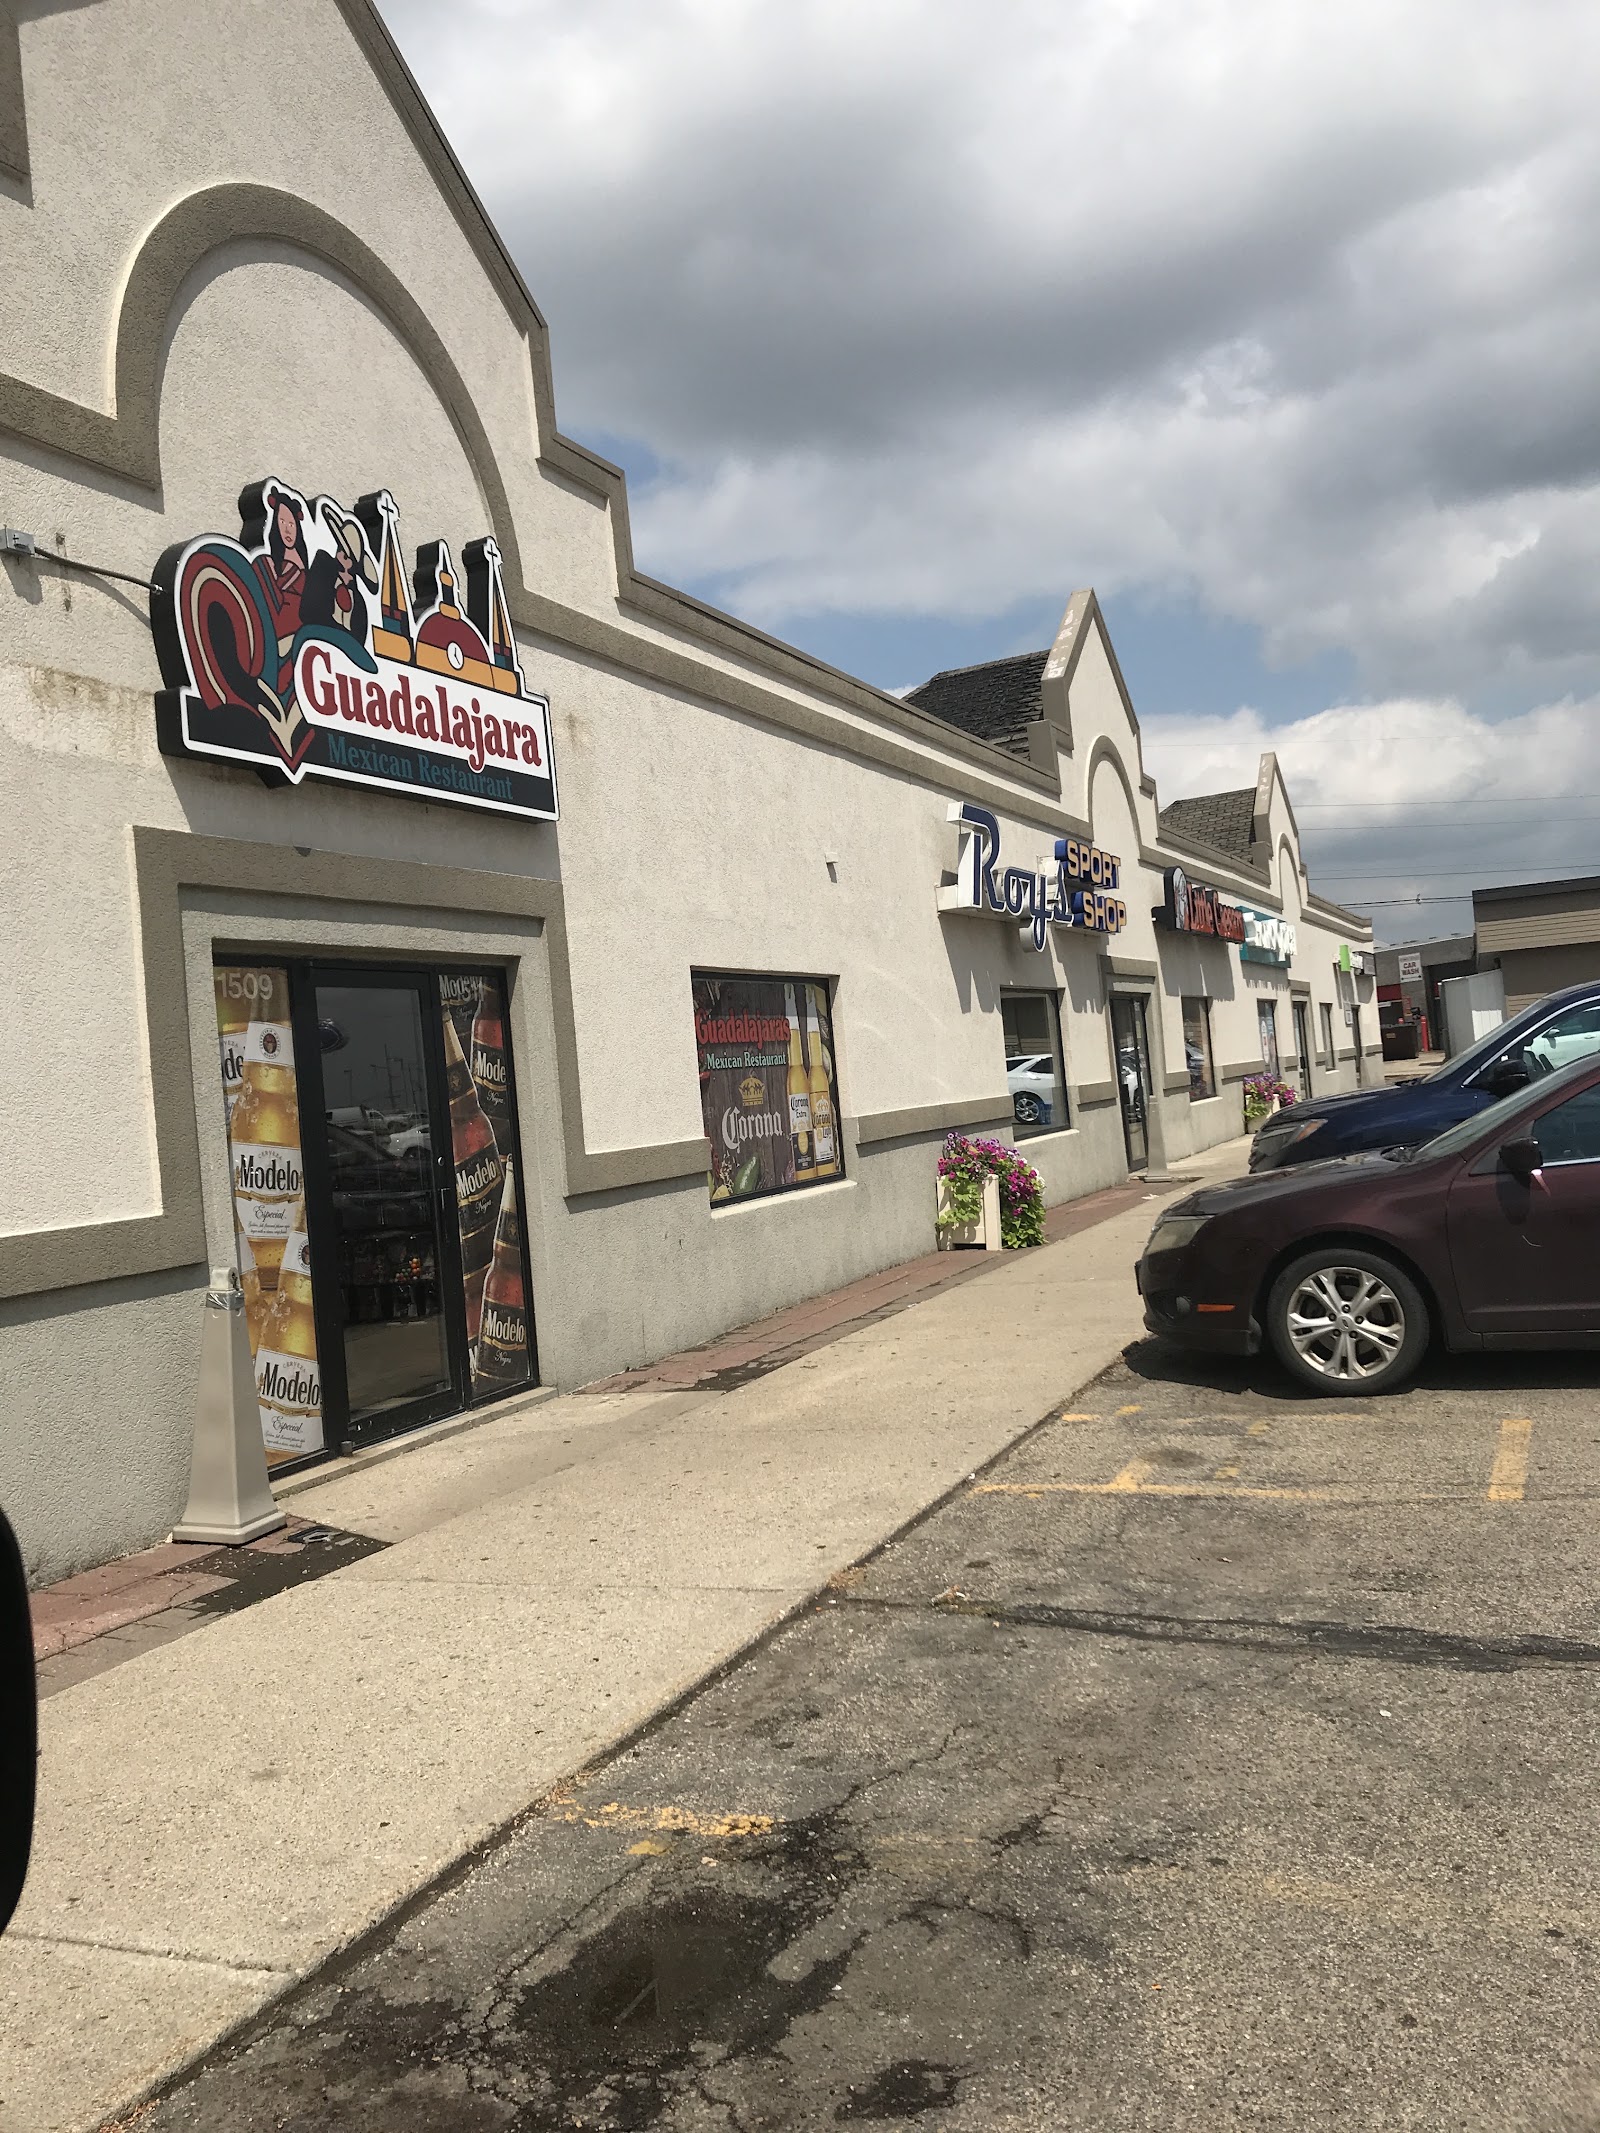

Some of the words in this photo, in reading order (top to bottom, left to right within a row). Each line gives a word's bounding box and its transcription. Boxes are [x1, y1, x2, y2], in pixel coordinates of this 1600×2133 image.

[301, 645, 541, 771] Guadalajara
[328, 733, 412, 780] Mexican
[419, 755, 513, 800] Restaurant
[1062, 839, 1121, 889] SPORT
[1078, 891, 1127, 934] SHOP
[218, 972, 273, 1000] 1509
[1401, 968, 1420, 976] WASH
[706, 1051, 743, 1070] Mexican
[744, 1051, 787, 1068] Restaurant
[721, 1106, 783, 1154] Corona
[240, 1154, 299, 1191] Modelo
[456, 1157, 497, 1199] Modelo
[486, 1308, 525, 1343] Modelo
[262, 1361, 320, 1406] Modelo
